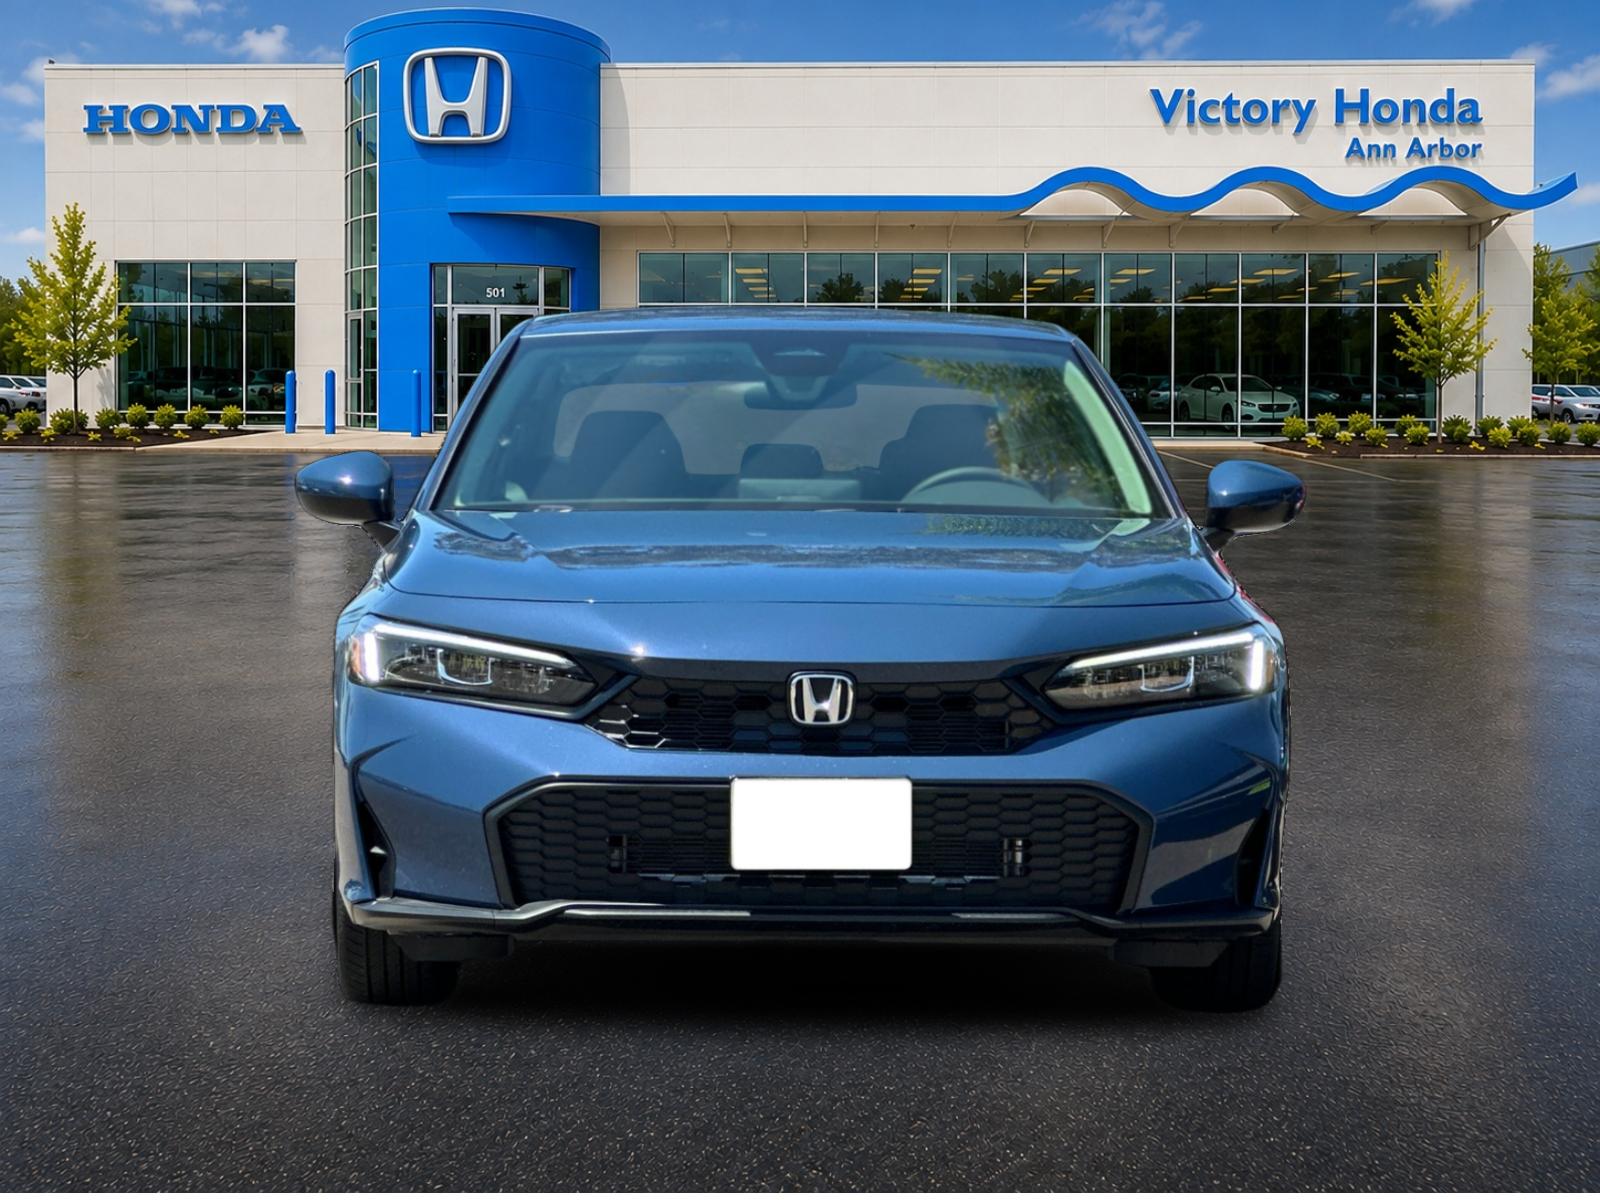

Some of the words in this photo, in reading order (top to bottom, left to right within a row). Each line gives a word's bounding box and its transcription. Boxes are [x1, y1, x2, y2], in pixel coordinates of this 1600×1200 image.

[83, 103, 303, 135] HONDA
[1149, 88, 1317, 135] Victory
[1334, 88, 1483, 126] Honda
[1345, 137, 1397, 160] Ann
[1405, 137, 1483, 160] Arbor
[485, 287, 506, 298] 501
